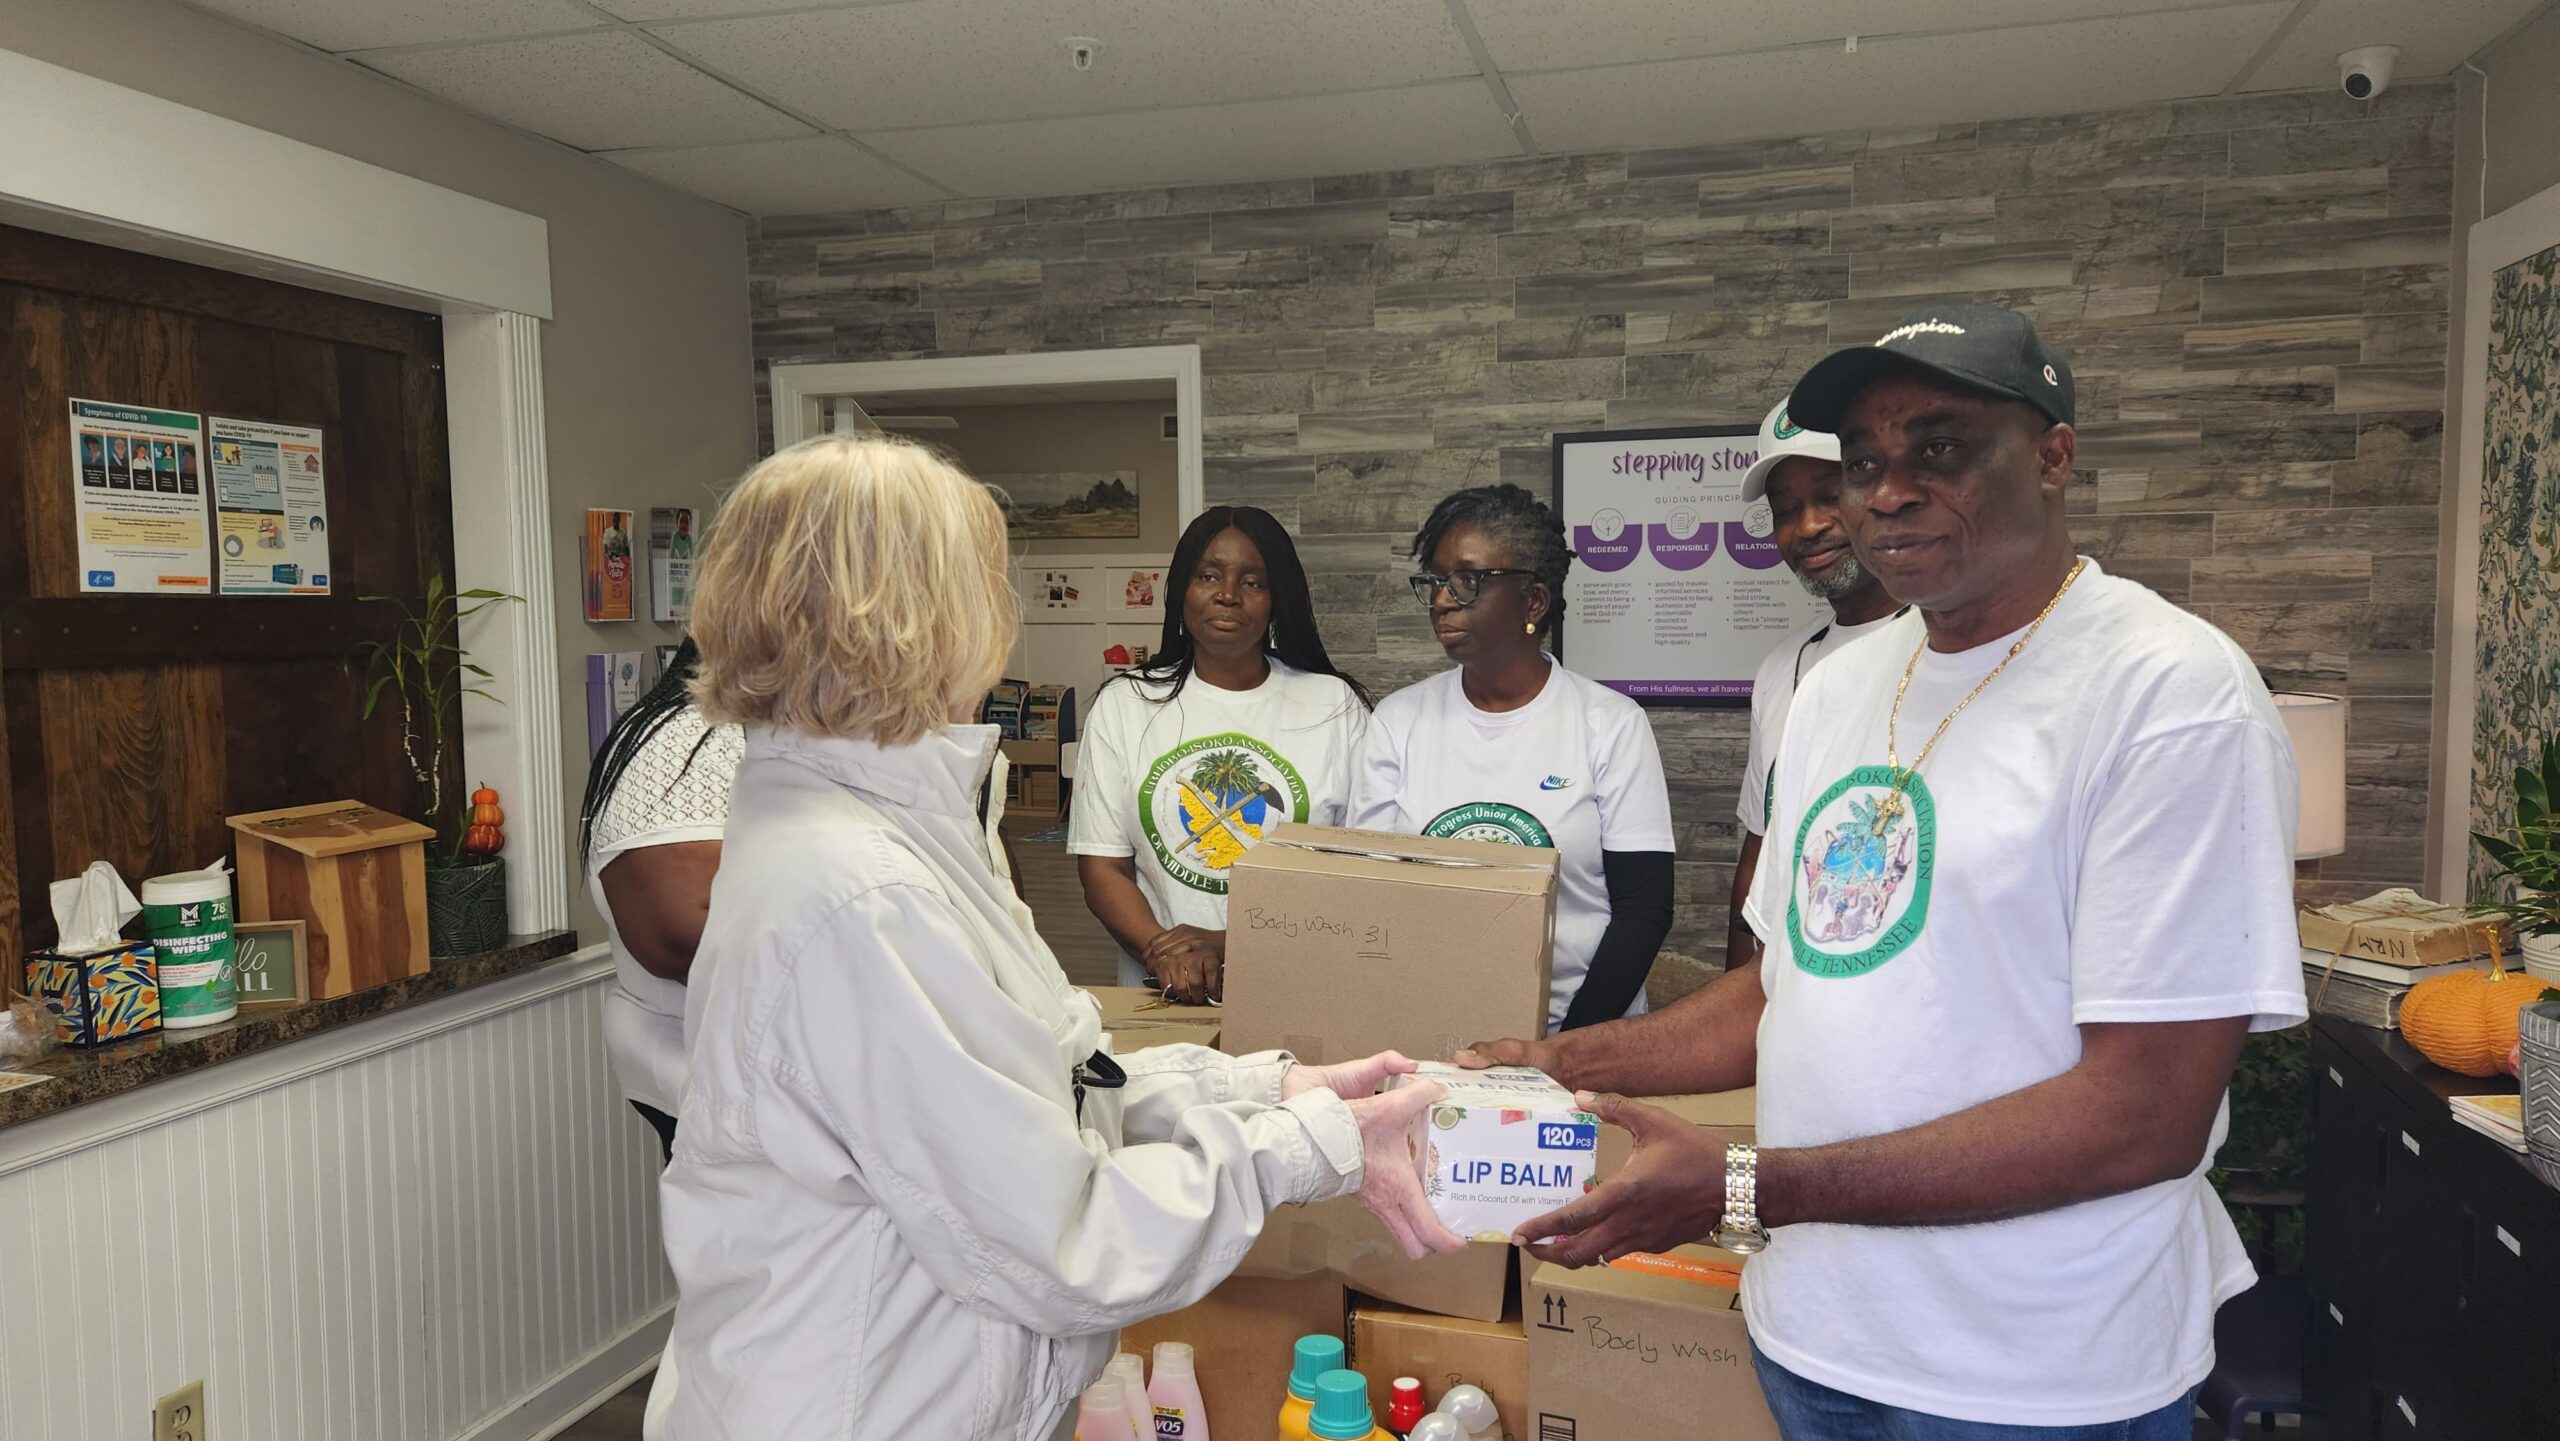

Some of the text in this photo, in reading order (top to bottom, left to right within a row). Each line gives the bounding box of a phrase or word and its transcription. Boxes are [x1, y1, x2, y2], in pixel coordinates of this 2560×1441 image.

[84, 407, 148, 422] Symptoms of COVID-19
[1612, 447, 1760, 483] stepping ston
[1655, 494, 1741, 504] GUIDING PRINCIP
[1587, 545, 1629, 554] REDEEMED
[1656, 544, 1710, 552] RESPONSIBLE
[1735, 542, 1778, 551] RELATIONA
[1629, 684, 1649, 693] From
[1650, 684, 1663, 693] His
[1664, 684, 1696, 693] fullness,
[1710, 684, 1720, 693] all
[1721, 684, 1740, 693] have
[1236, 737, 1304, 804] ASSOCIATION
[1546, 774, 1571, 788] NIKE
[1430, 810, 1472, 837] Progress
[1475, 807, 1507, 820] Union
[1508, 812, 1542, 847] America
[1161, 853, 1213, 889] MIDDLE
[211, 902, 226, 915] 78
[211, 913, 229, 922] WIPES
[1244, 907, 1298, 938] Body
[1364, 925, 1389, 949] 31
[152, 931, 228, 947] DISINFECTING
[1821, 917, 1918, 974] TENNESSEE
[171, 943, 211, 955] WIPES
[1476, 1083, 1551, 1093] BALM
[1542, 1126, 1592, 1148] 120 PCS
[1452, 1160, 1573, 1188] LIP BALM
[1450, 1192, 1467, 1201] Rich
[1477, 1193, 1508, 1203] Coconut
[1509, 1195, 1520, 1204] Oil
[1521, 1196, 1536, 1204] with
[1537, 1196, 1564, 1205] Vitamin
[1582, 1316, 1659, 1364] Body
[1155, 1419, 1182, 1433] VO5
